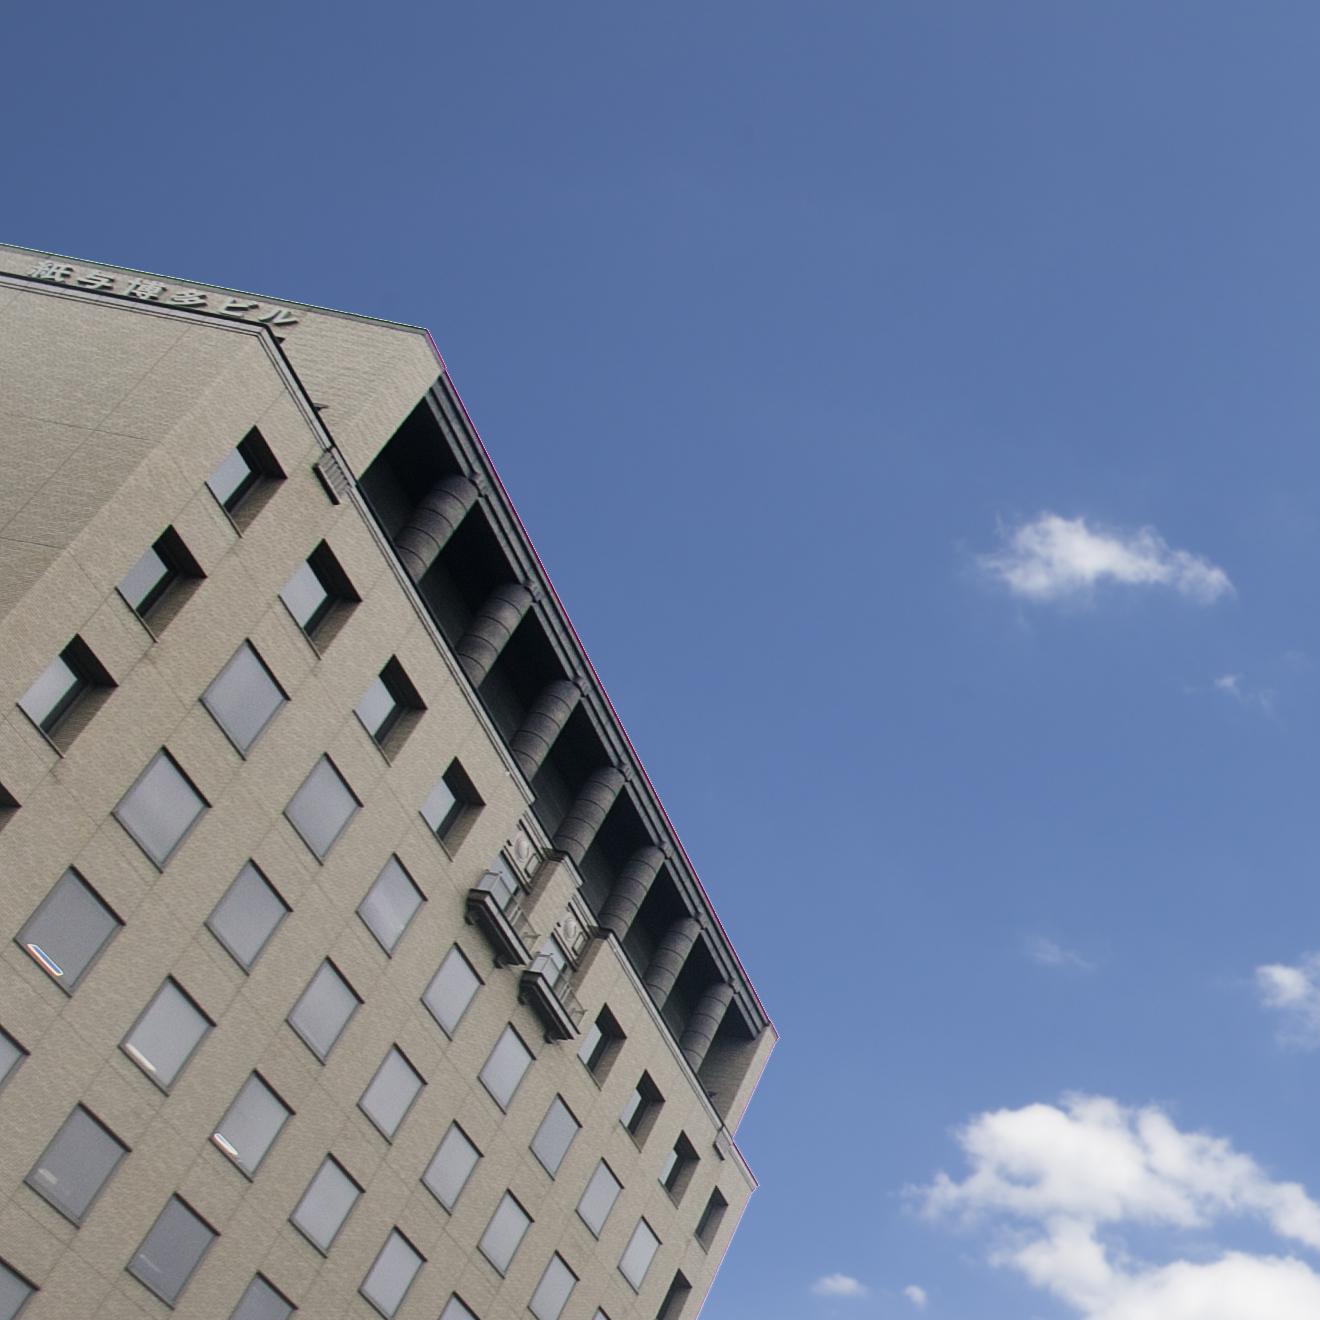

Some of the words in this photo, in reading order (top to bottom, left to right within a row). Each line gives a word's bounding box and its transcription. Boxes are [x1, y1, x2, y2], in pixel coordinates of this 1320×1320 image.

[28, 259, 299, 326] 紙与博多ビル
